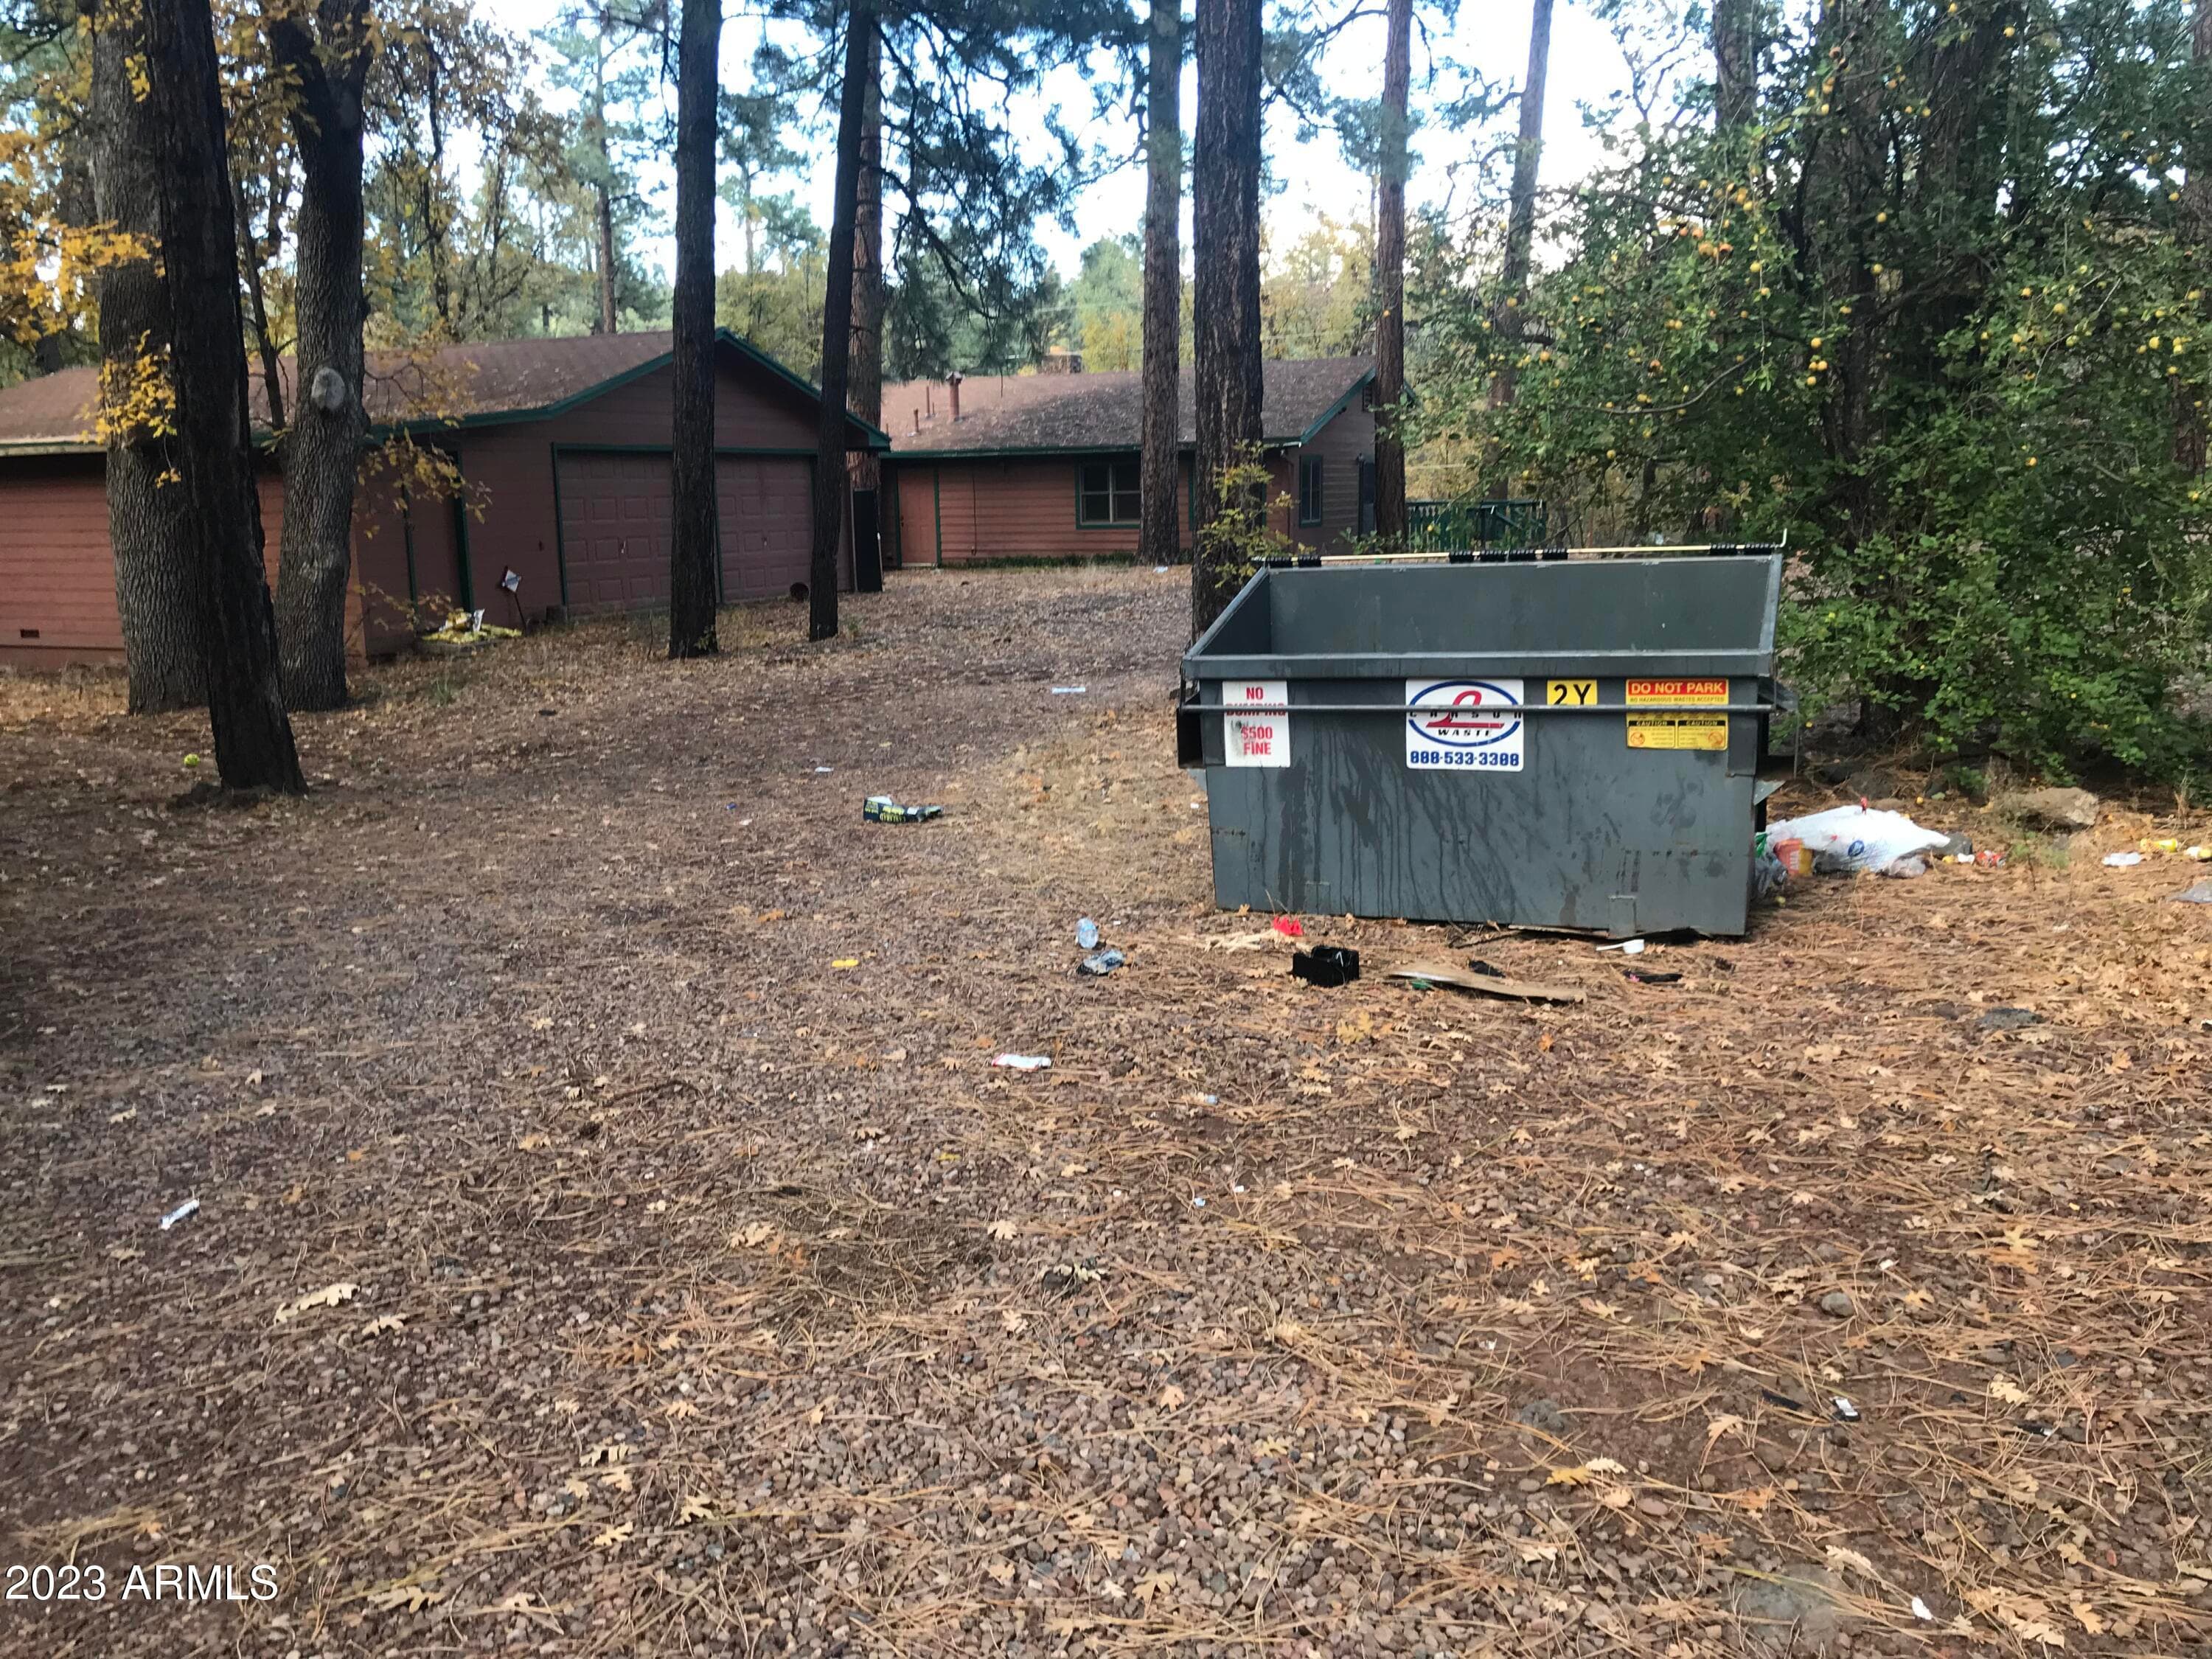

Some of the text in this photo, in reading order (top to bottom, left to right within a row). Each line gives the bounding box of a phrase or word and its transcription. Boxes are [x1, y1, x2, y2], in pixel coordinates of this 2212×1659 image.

[1245, 686, 1264, 700] NO
[1554, 684, 1592, 705] 2Y
[1631, 682, 1724, 694] DO NOT PARK
[1241, 726, 1273, 740] $500
[1243, 742, 1271, 755] FINE
[1410, 751, 1520, 766] 888-533-3388
